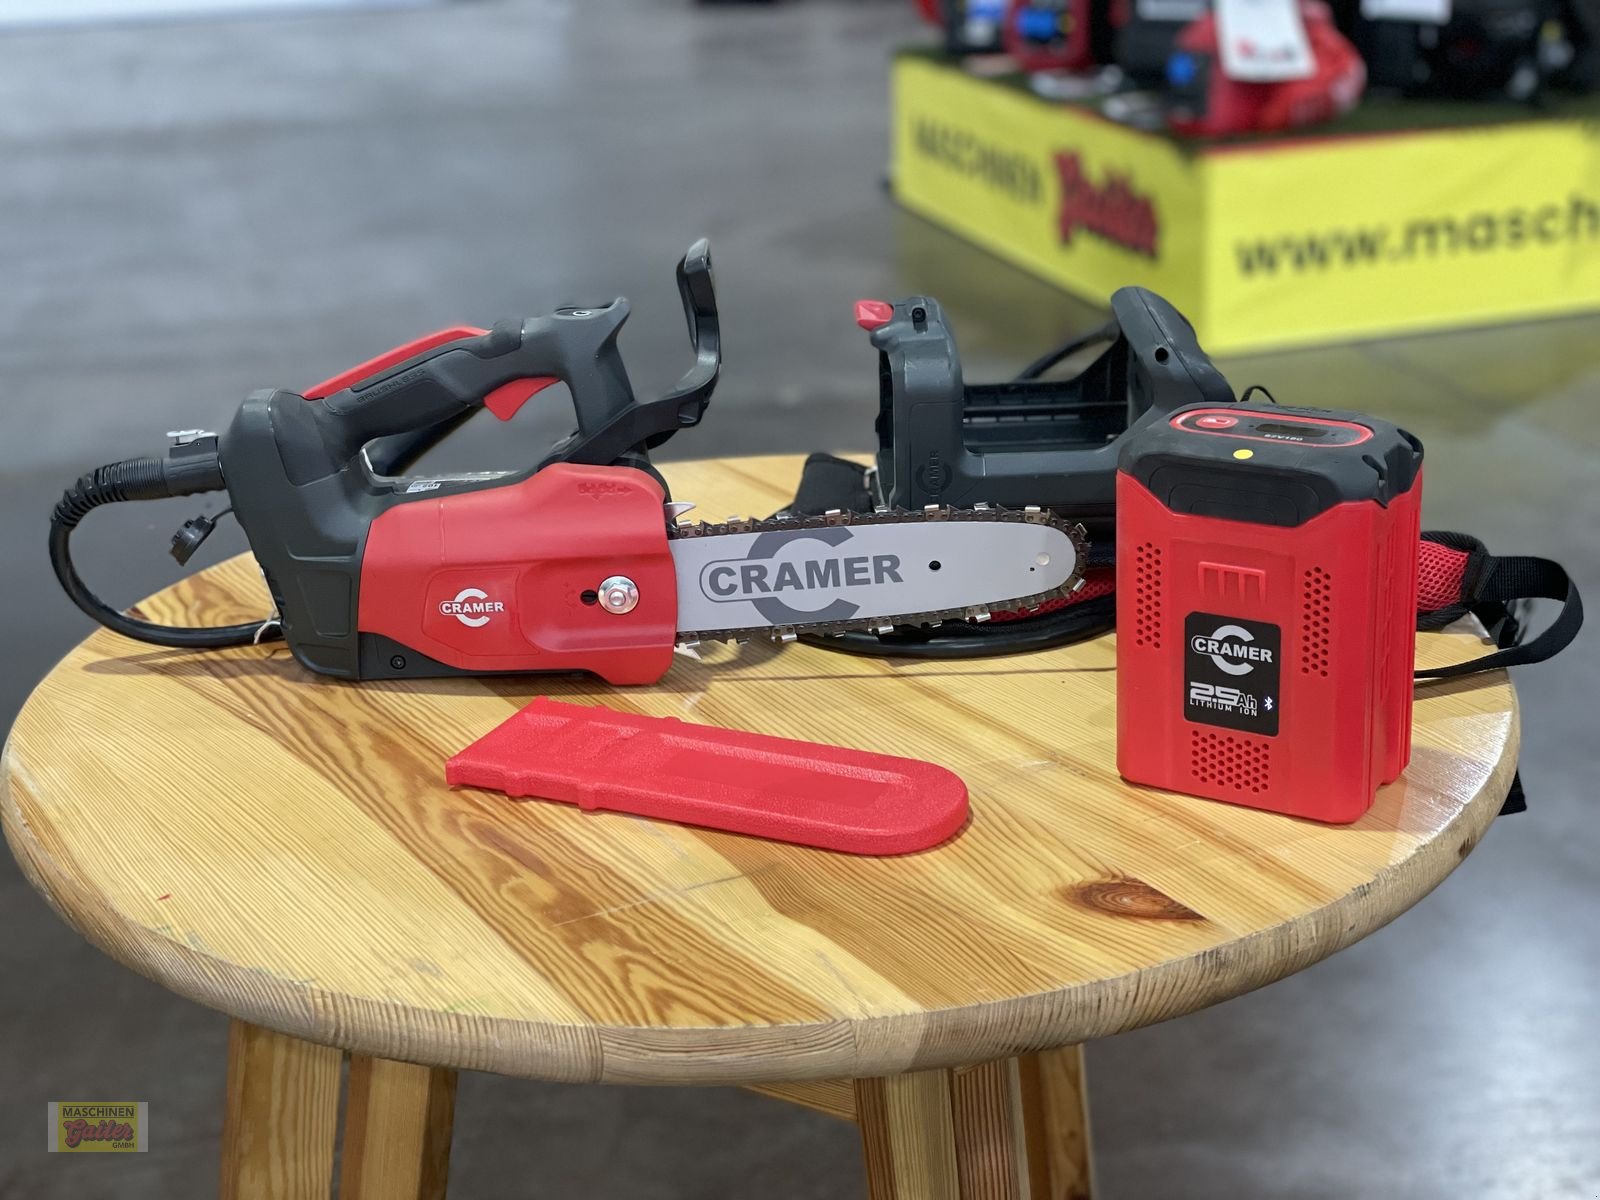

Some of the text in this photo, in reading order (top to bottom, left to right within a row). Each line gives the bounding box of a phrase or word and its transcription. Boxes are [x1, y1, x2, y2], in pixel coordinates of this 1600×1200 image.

[708, 554, 904, 596] CRAMER
[441, 602, 505, 614] CRAMER
[1194, 638, 1273, 663] CRAMER
[1190, 698, 1257, 717] LITHIUM ION
